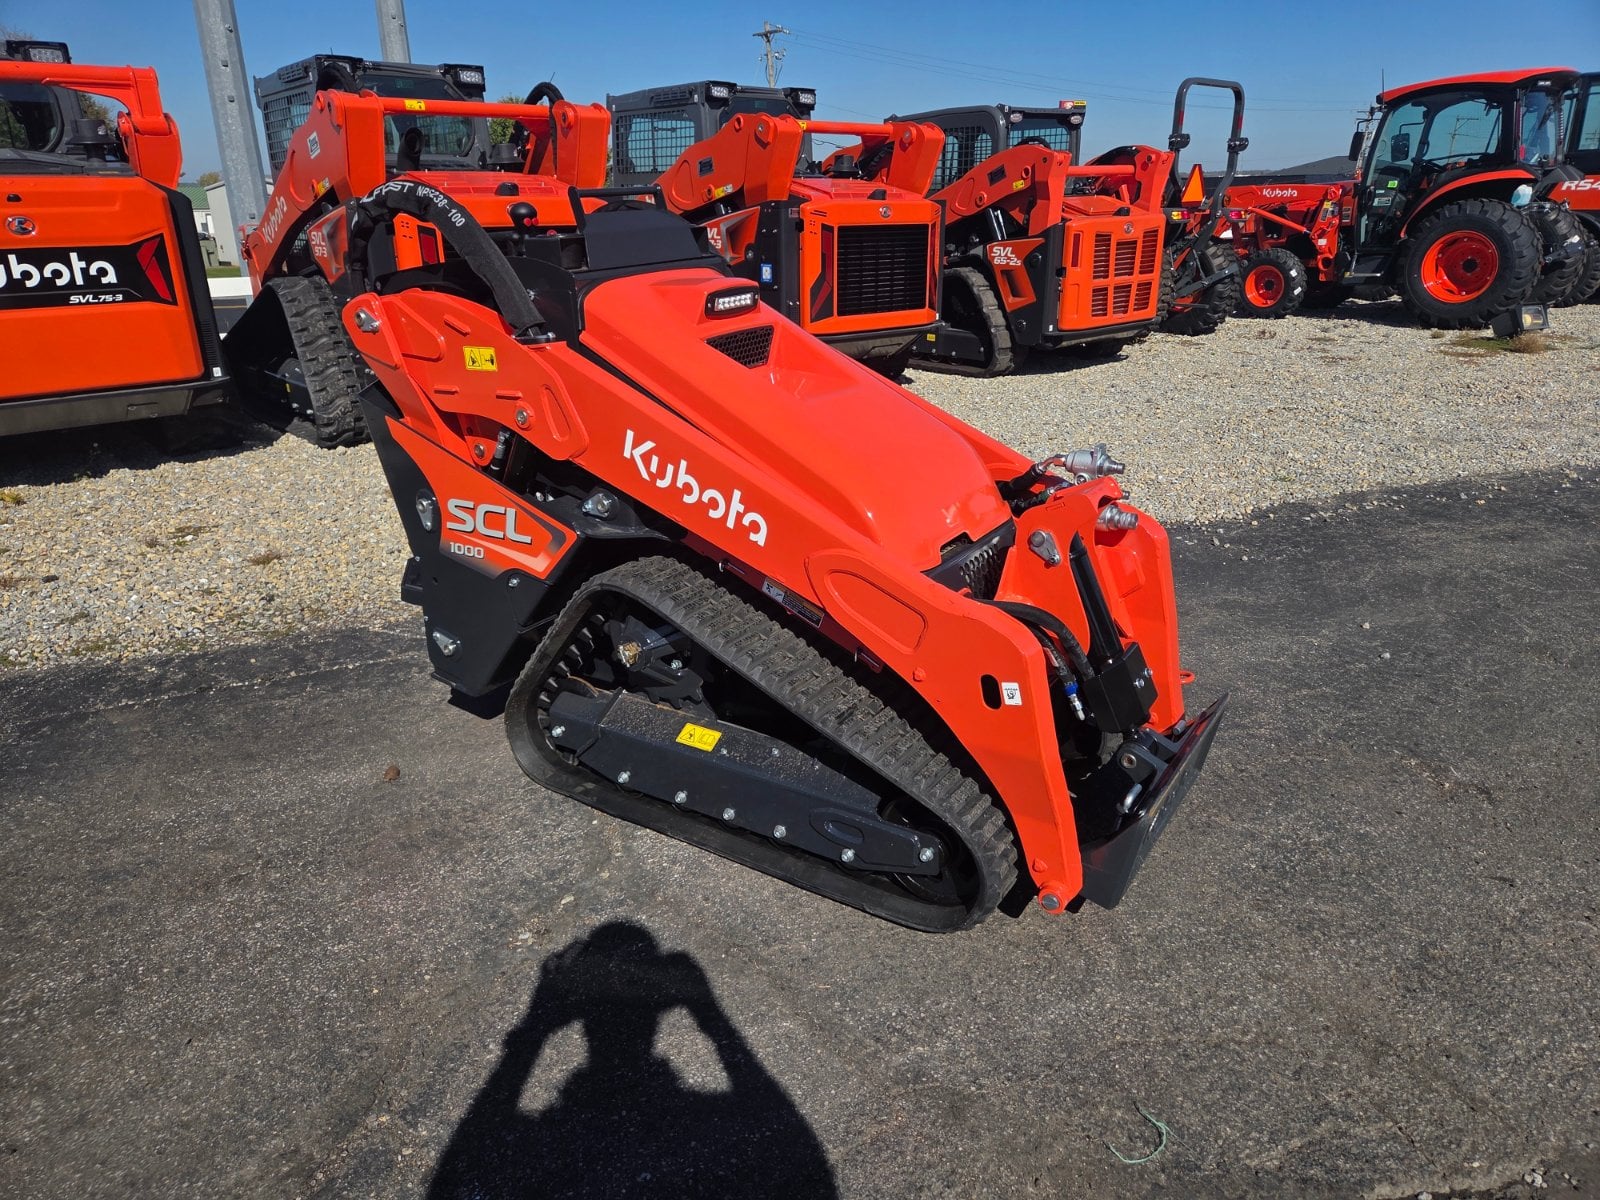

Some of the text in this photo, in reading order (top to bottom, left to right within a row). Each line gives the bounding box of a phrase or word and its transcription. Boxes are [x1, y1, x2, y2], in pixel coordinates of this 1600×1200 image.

[1262, 187, 1298, 198] Kubota
[262, 196, 288, 243] Kubota
[311, 231, 326, 246] SVL
[707, 227, 721, 239] VL
[990, 246, 1016, 257] SVL
[0, 252, 118, 288] bota
[69, 294, 123, 304] SVL75-3
[623, 428, 768, 548] Kubota
[446, 498, 533, 545] SCL
[450, 541, 486, 560] 1000
